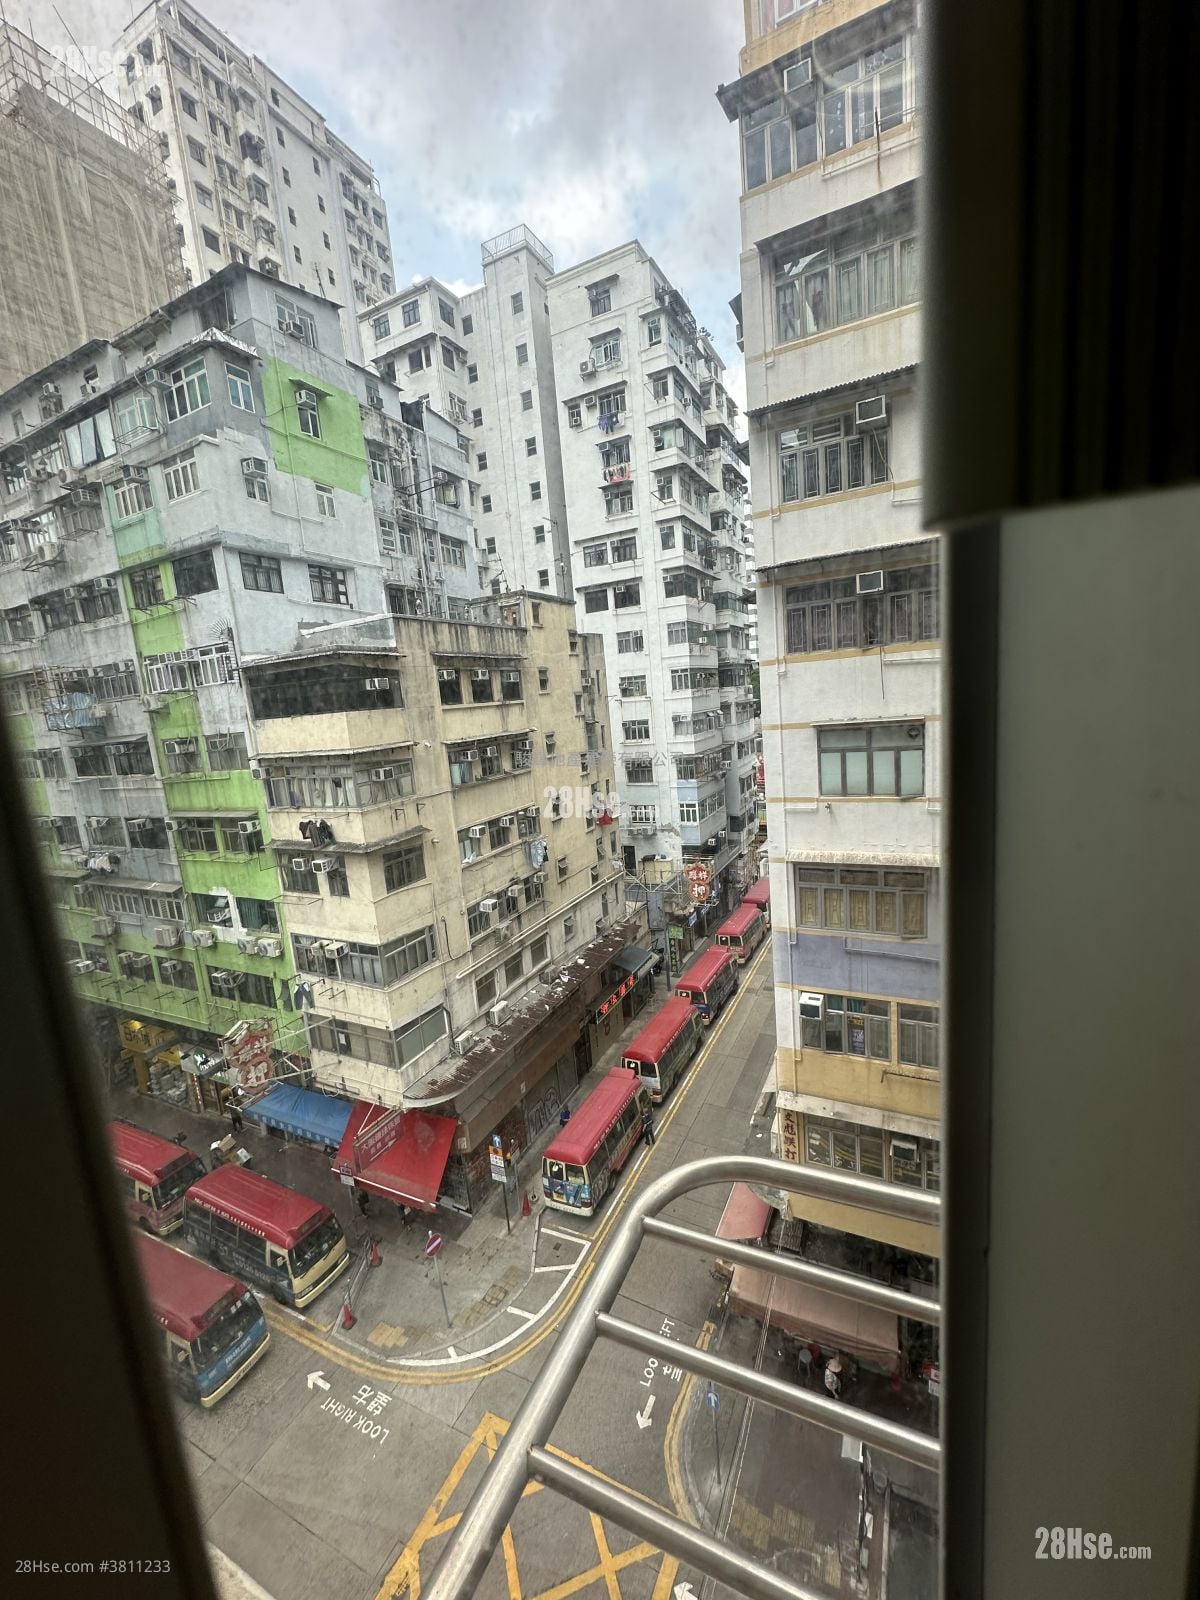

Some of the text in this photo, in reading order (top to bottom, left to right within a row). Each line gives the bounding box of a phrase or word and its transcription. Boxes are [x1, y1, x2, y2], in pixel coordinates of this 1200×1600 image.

[692, 883, 706, 898] 押
[640, 1357, 659, 1387] LOO
[352, 1384, 392, 1416] 望右
[320, 1396, 390, 1445] LOOK RIGHT
